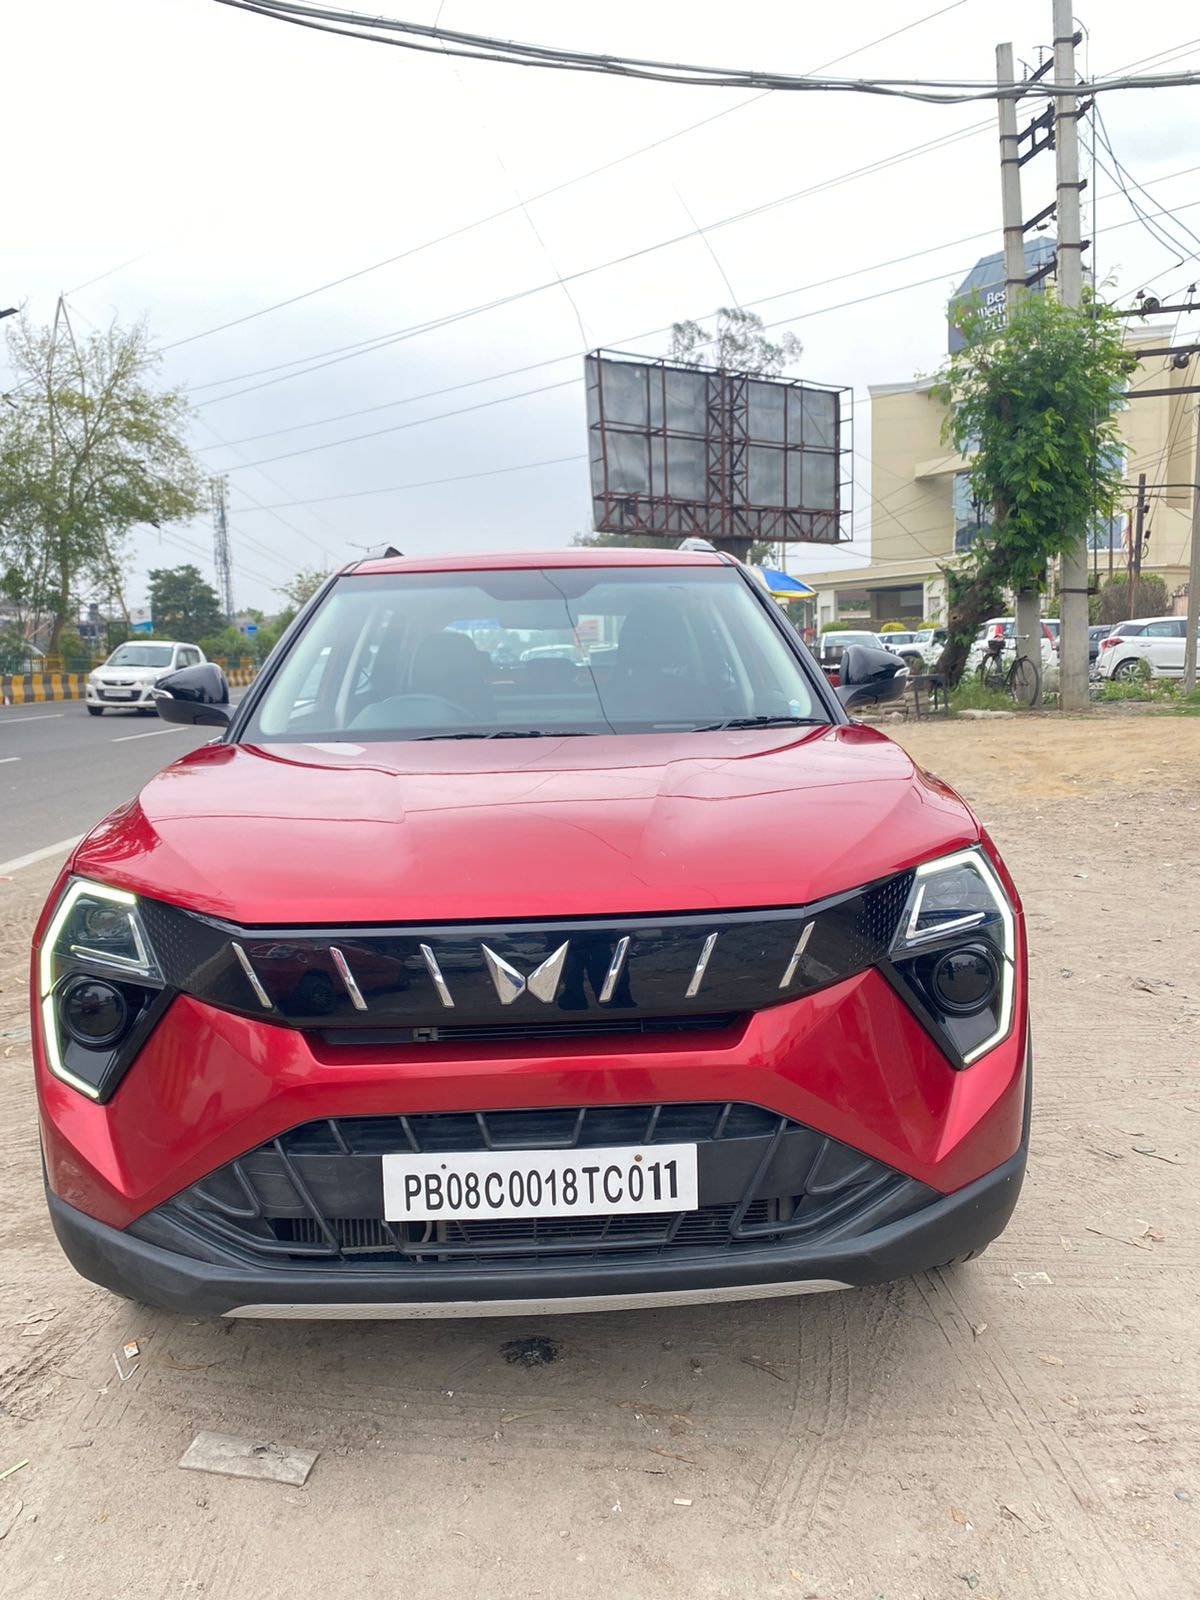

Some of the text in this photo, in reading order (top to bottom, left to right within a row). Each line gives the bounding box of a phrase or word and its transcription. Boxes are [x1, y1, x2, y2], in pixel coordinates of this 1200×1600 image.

[987, 290, 1006, 305] Bes
[977, 303, 1008, 317] Weste
[984, 315, 1006, 331] PLU
[404, 1159, 678, 1212] PB08C0018TC011
